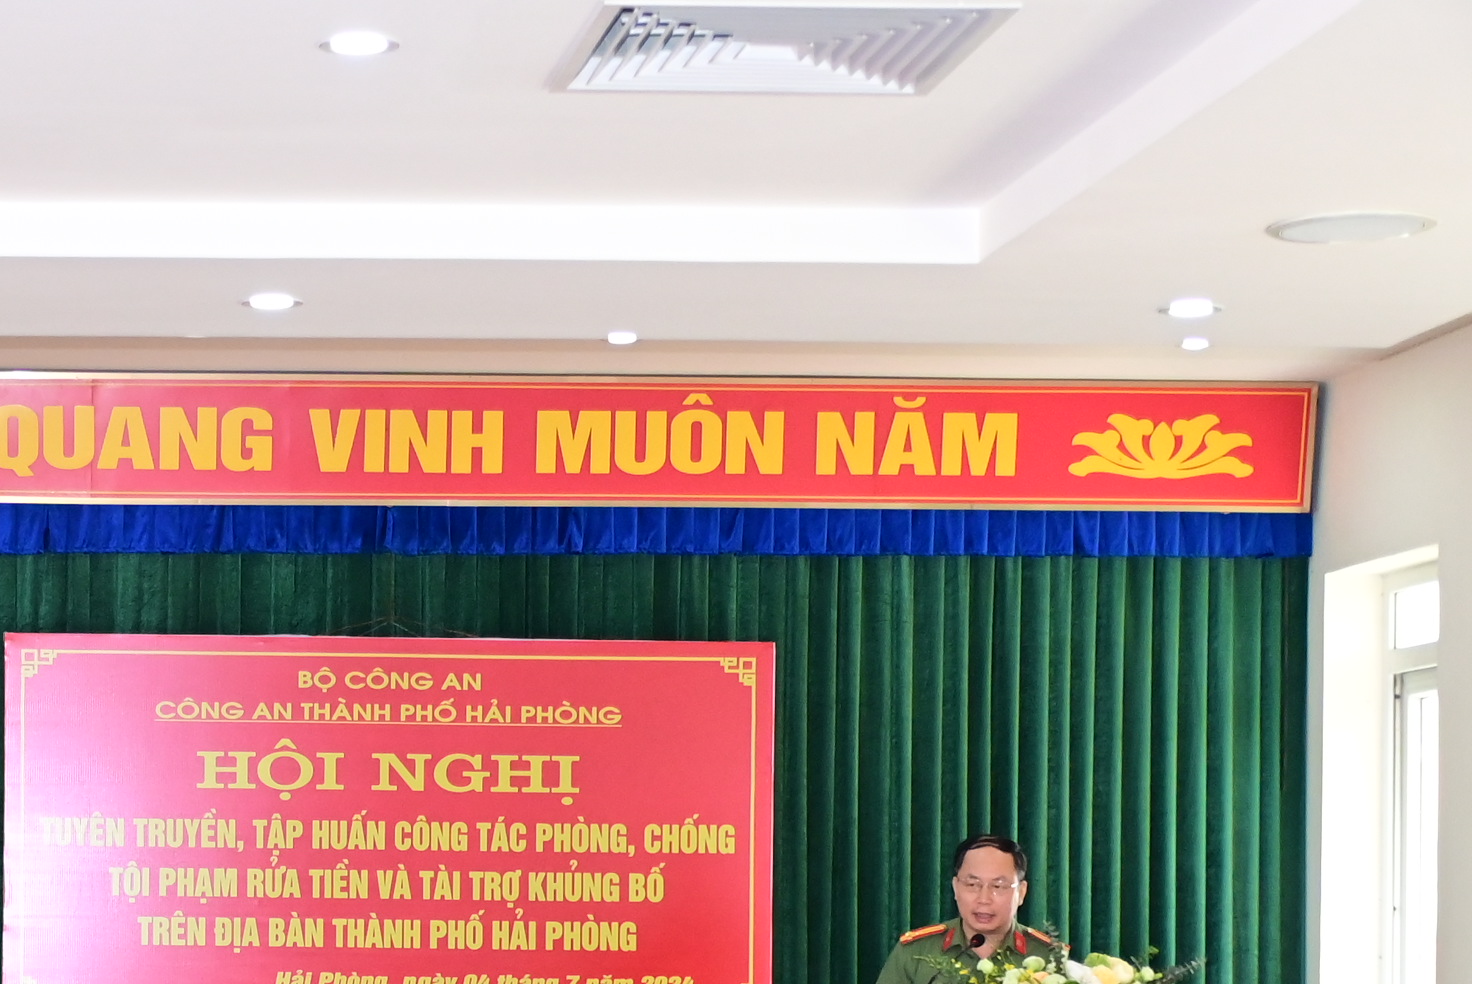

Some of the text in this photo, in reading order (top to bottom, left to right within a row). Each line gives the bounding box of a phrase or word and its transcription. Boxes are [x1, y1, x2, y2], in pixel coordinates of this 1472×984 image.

[309, 409, 503, 473] VINH
[536, 393, 784, 475] MUÔN
[816, 396, 1018, 476] NĂM
[299, 667, 481, 692] BỘ CÔNG AN
[155, 697, 623, 725] CÔNG AN THÀNH PHỐ HẢI PHÒNG
[196, 738, 580, 805] HỘI NGHỊ
[40, 808, 735, 856] TUYÊN TRUYỀN, TẬP HUẤN CÔNG TÁC PHÒNG, CHỐNG
[109, 856, 665, 908] TỘI PHẠM RỬA TIỀN VÀ TÀI TRỢ KHỦNG BỐ
[137, 908, 636, 953] TRÊN ĐỊA BÀN THÀNH PHỐ HẢI PHÒNG
